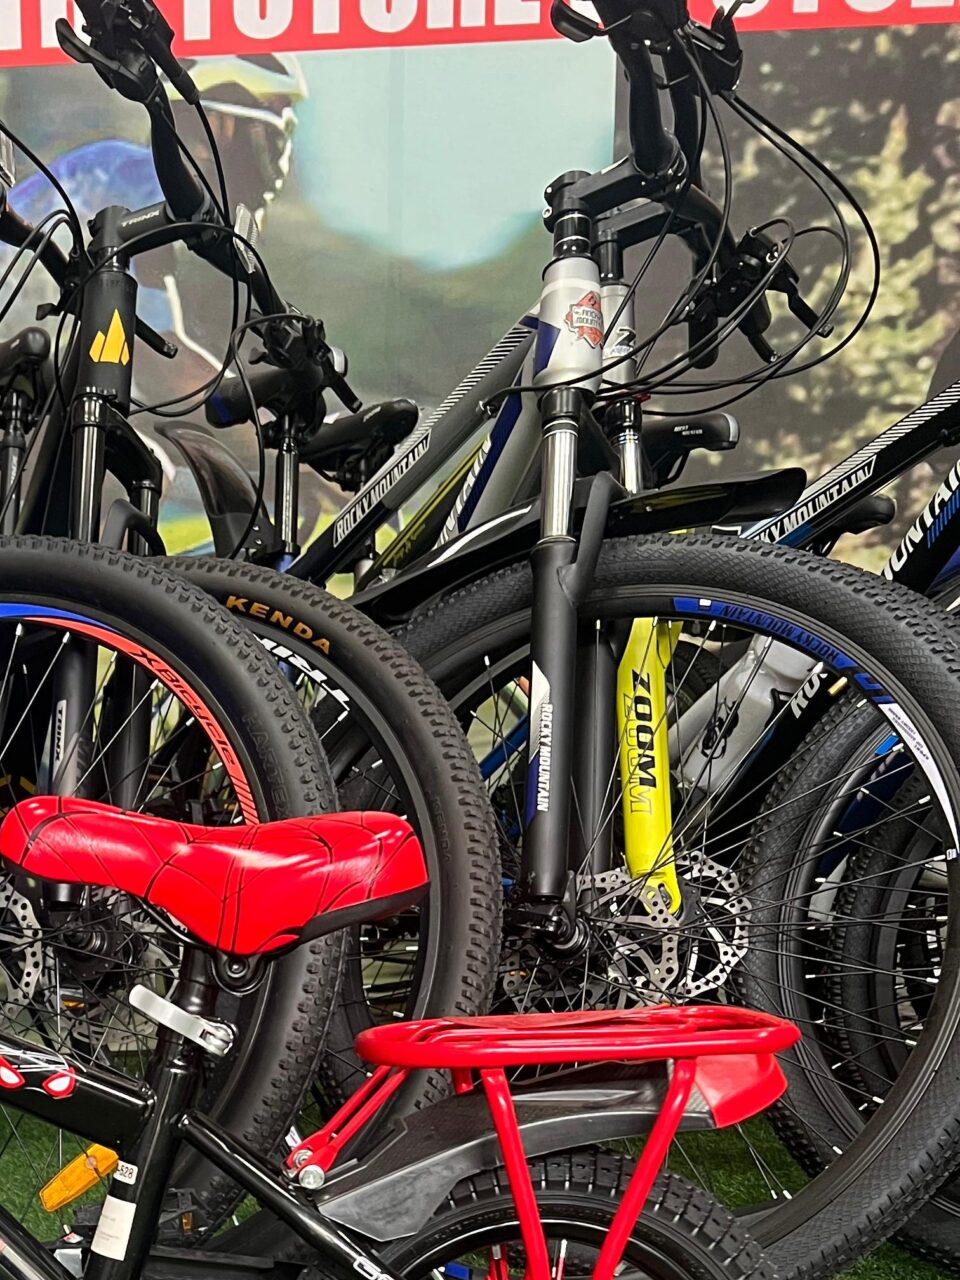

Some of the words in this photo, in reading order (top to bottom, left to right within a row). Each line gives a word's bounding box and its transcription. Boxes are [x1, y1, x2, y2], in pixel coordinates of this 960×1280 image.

[121, 210, 160, 228] TRINX
[336, 491, 372, 543] ROCKY
[368, 438, 428, 505] MOUNTAIN
[782, 464, 872, 537] MOUNTAIN
[225, 595, 331, 655] KENDA
[54, 708, 64, 762] TRINX
[540, 703, 554, 745] ROCKY
[632, 669, 657, 789] ZOOM
[537, 746, 553, 812] MOUNTAIN
